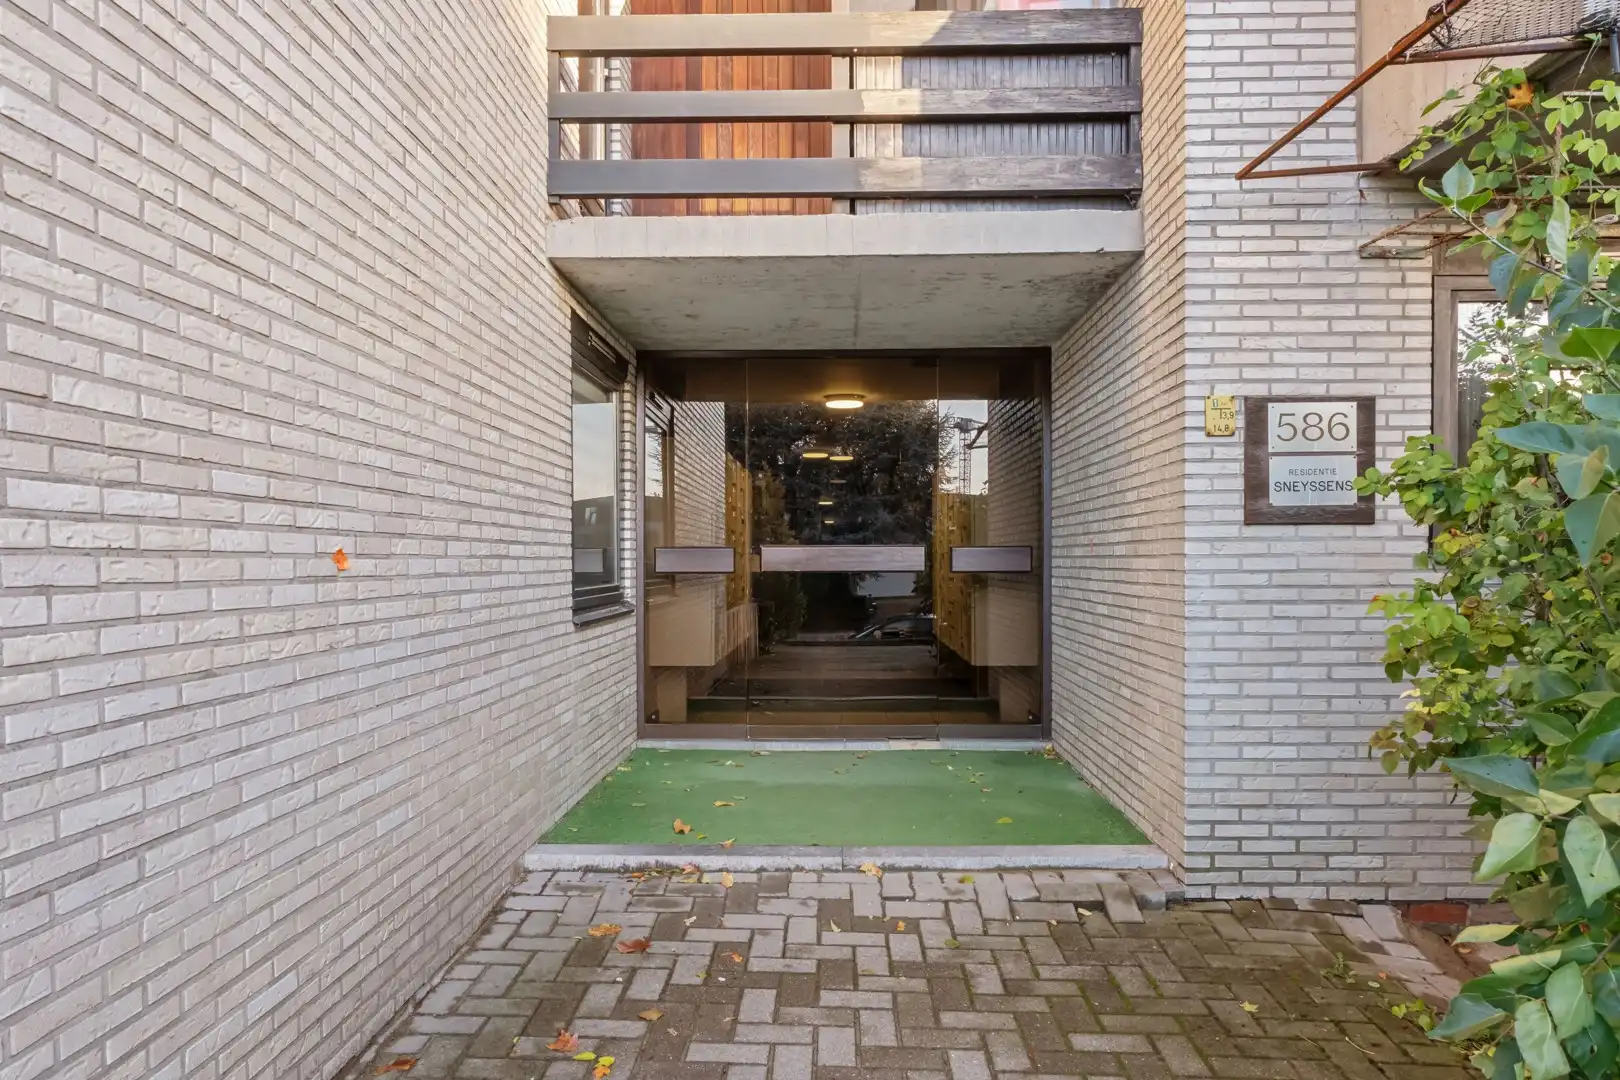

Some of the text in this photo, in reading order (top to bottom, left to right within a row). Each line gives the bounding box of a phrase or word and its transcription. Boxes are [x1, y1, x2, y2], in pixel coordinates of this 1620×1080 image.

[1276, 412, 1350, 442] 586
[1288, 468, 1338, 476] RESIDENTIE
[1273, 480, 1353, 493] SNEYSSENS
